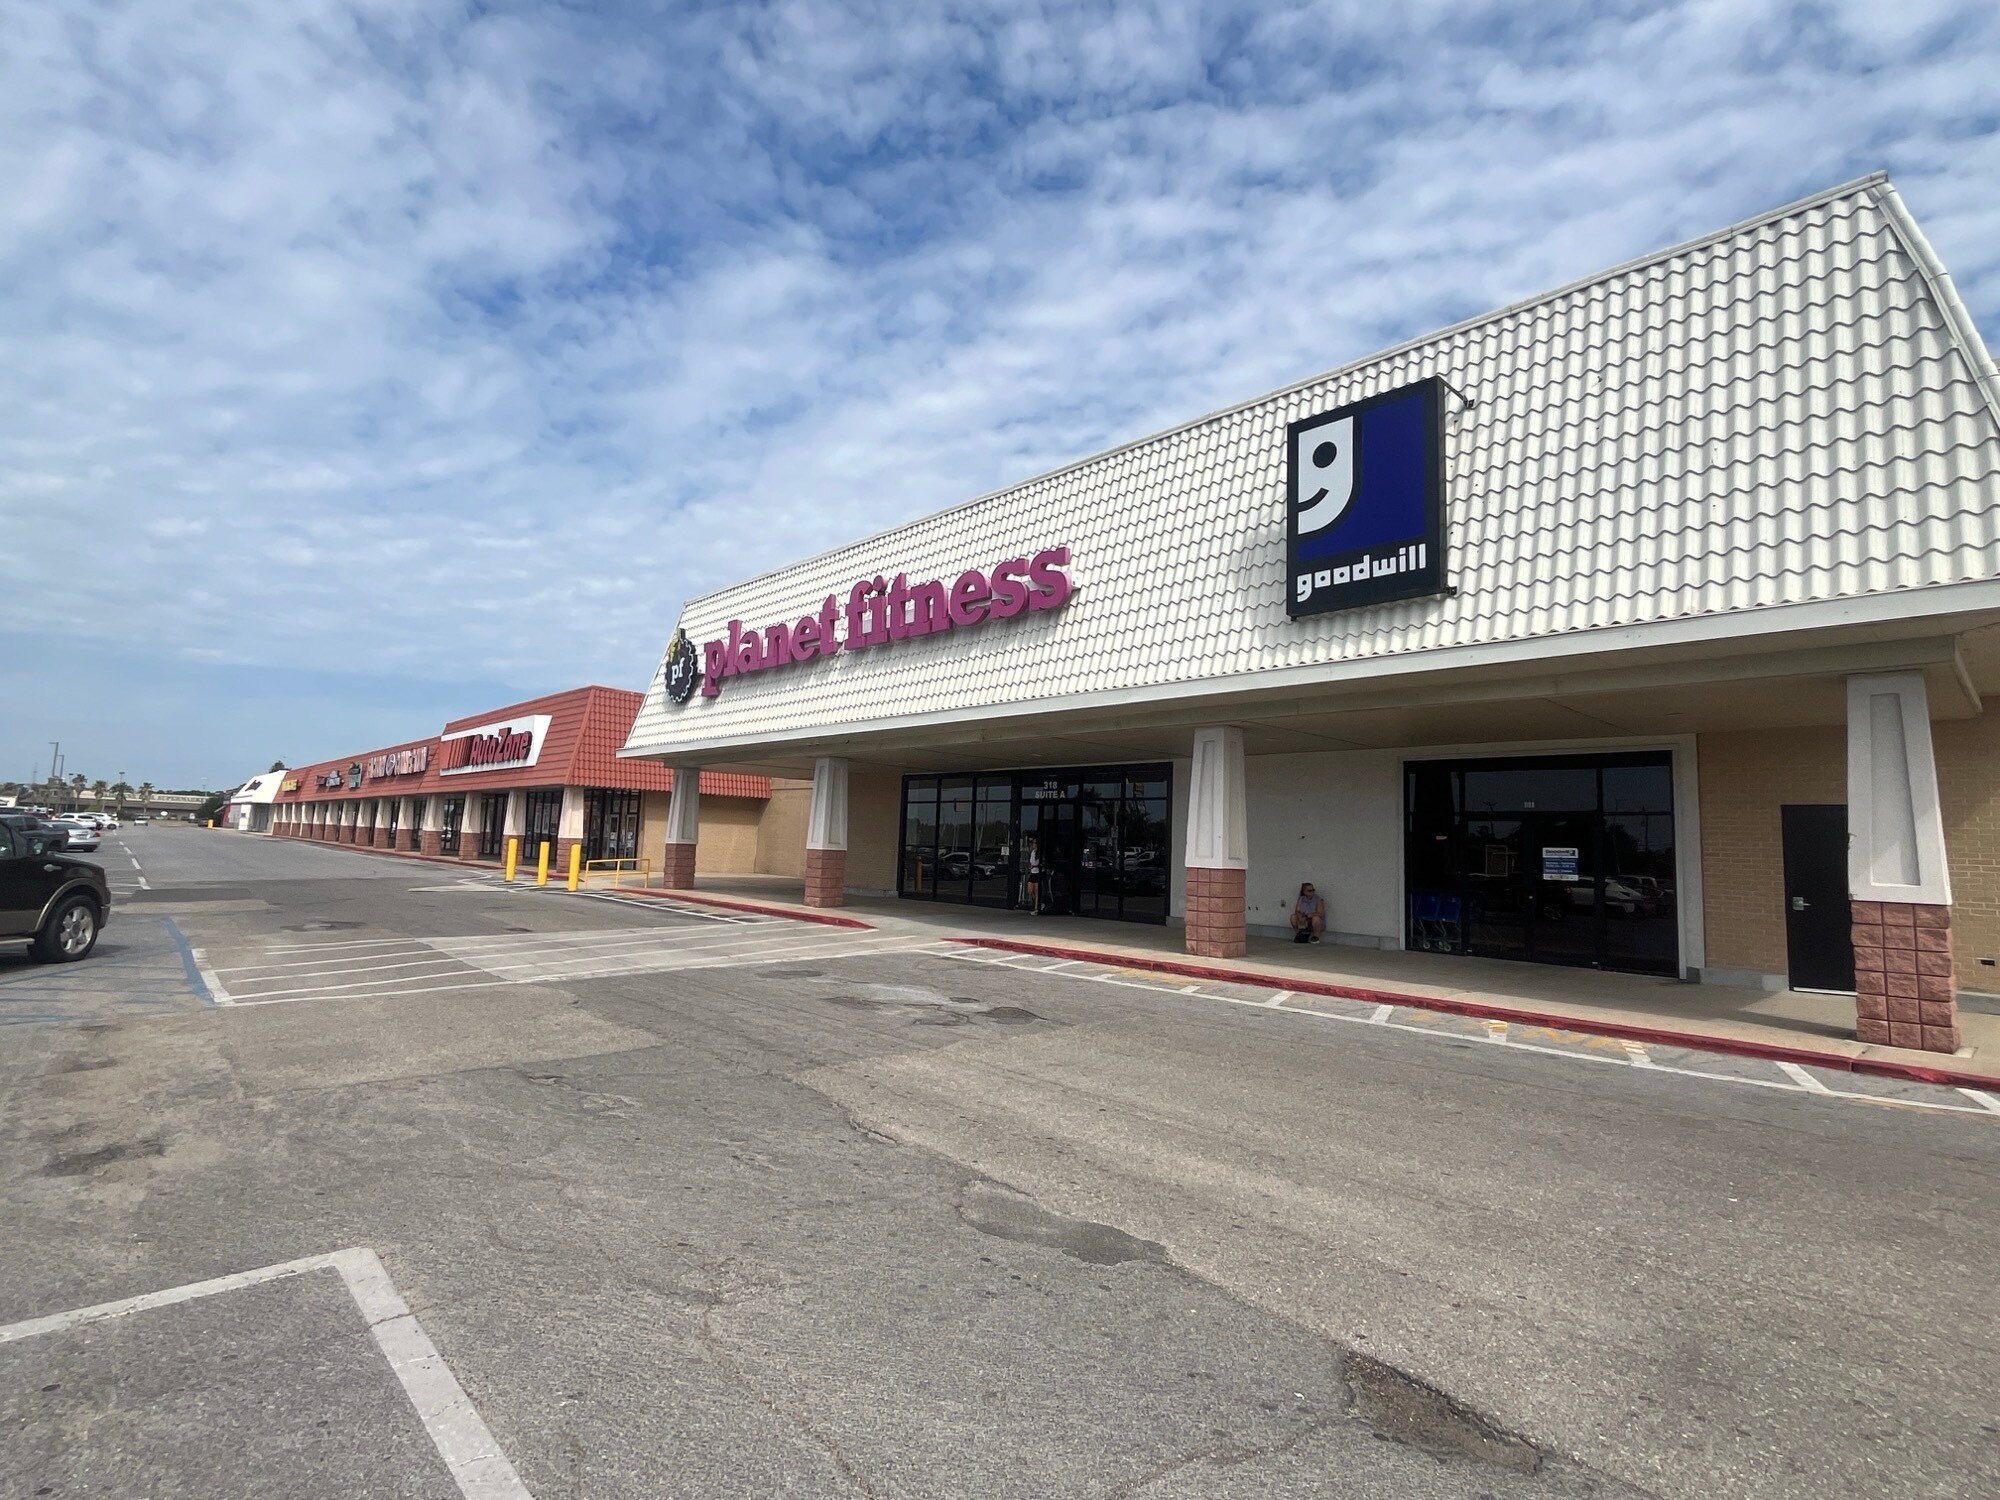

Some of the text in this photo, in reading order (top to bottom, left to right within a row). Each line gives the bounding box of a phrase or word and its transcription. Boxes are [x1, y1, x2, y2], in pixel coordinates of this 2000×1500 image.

[1296, 543, 1427, 603] goodwill
[701, 546, 1073, 697] planet fitness
[670, 657, 686, 686] pf
[469, 727, 533, 766] AutoZone
[1034, 790, 1066, 799] SUITE A
[1043, 781, 1058, 790] 318
